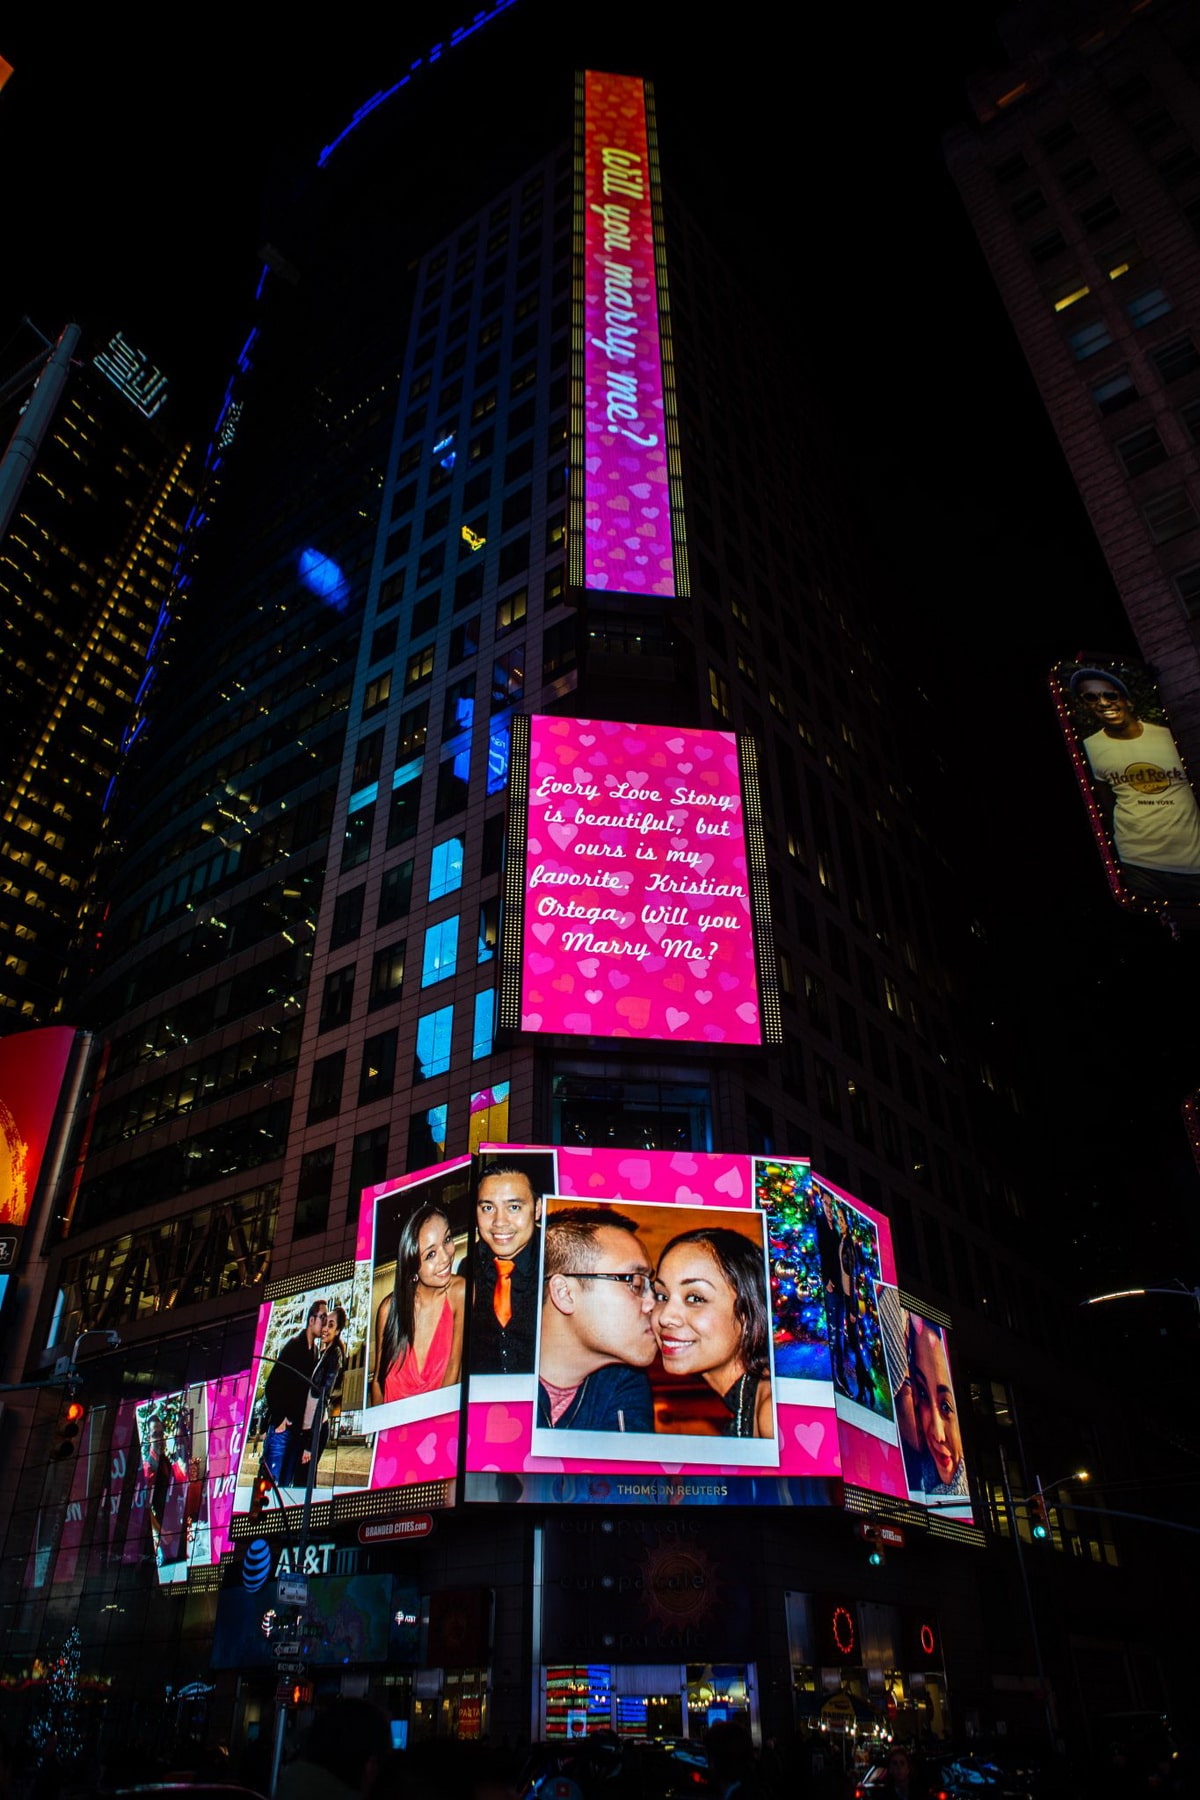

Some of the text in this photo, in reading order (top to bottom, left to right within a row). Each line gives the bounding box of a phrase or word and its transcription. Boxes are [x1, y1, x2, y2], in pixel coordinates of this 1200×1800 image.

[590, 147, 658, 446] Will you marry me?
[536, 776, 734, 809] Every Love Story
[1110, 767, 1183, 786] Hard Rock
[544, 805, 731, 837] is beautiful, but
[574, 841, 702, 868] ours is my
[529, 865, 746, 899] favorite. Kristian
[537, 897, 741, 932] Ortega, Will you
[561, 932, 719, 961] Marry Me?
[616, 1484, 728, 1496] THOMSON REUTERS
[365, 1524, 394, 1537] BRANDED
[275, 1543, 335, 1578] AT&T
